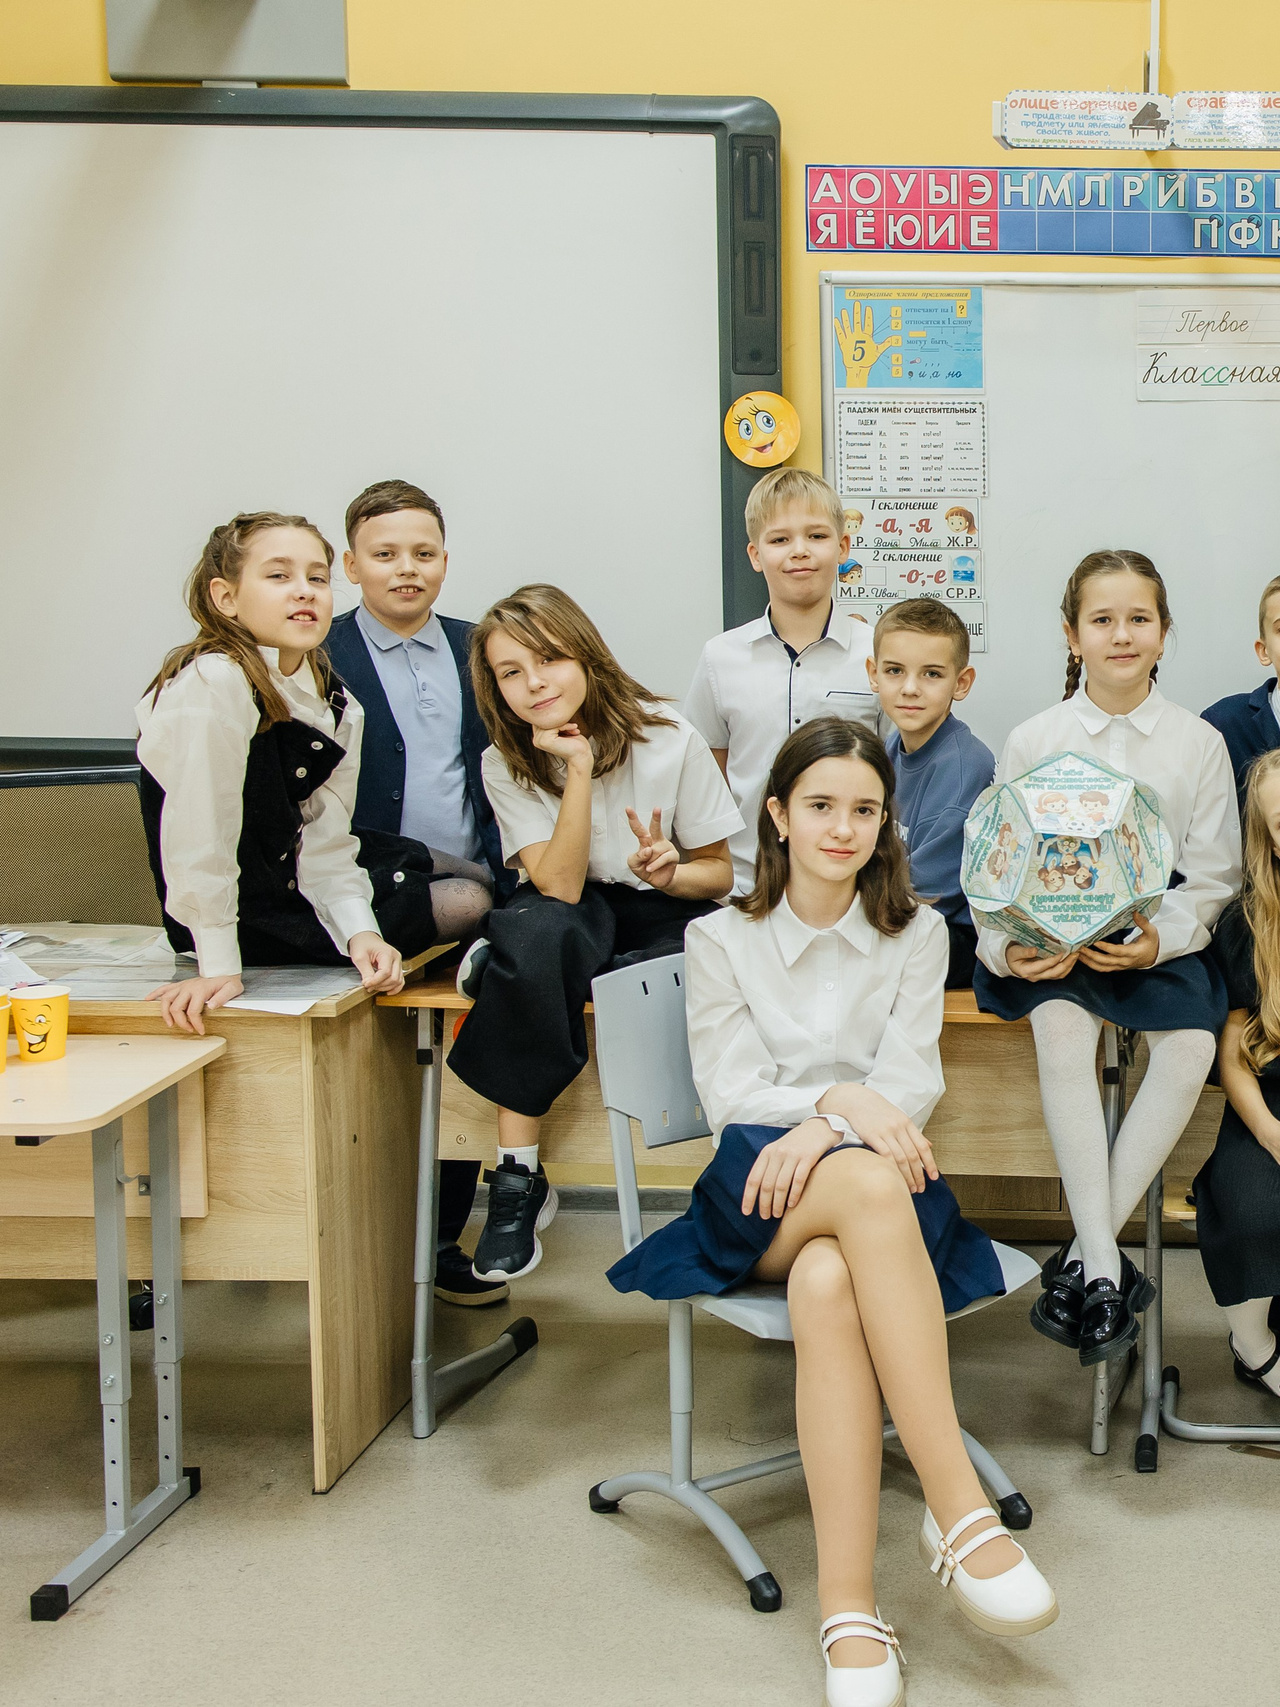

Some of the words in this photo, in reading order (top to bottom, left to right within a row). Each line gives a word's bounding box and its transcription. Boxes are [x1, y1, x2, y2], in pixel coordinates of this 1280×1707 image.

[1021, 121, 1065, 129] предмету
[812, 173, 843, 203] А
[849, 173, 882, 204] О
[890, 174, 918, 204] У
[929, 175, 957, 204] Ы
[967, 176, 993, 205] Э
[1004, 175, 1029, 205] Н
[1038, 176, 1072, 206] М
[1079, 176, 1106, 207] Л
[1123, 176, 1144, 206] Р
[1158, 171, 1184, 208] Й
[1197, 177, 1217, 208] Б
[1235, 177, 1256, 209] В
[816, 214, 837, 244] Я
[856, 210, 876, 244] Ё
[889, 215, 922, 246] Ю
[928, 215, 955, 246] И
[971, 215, 990, 246] Е
[1194, 219, 1217, 248] П
[1228, 218, 1260, 250] Ф
[1176, 310, 1249, 342] Первое
[852, 340, 866, 362] 5
[871, 500, 875, 510] 1
[878, 501, 938, 510] склонение
[909, 518, 932, 533] -я
[874, 537, 898, 547] Ваня
[910, 537, 939, 547] Мила
[947, 536, 977, 547] Ж.Р.
[873, 550, 880, 561] 2
[883, 552, 943, 562] склонение
[840, 587, 869, 598] М.Р.
[871, 588, 898, 598] Иван
[920, 590, 940, 598] окно
[947, 588, 980, 598] СР.Р.
[876, 605, 883, 616] 3
[1084, 894, 1115, 904] День
[1052, 914, 1091, 924] Когда
